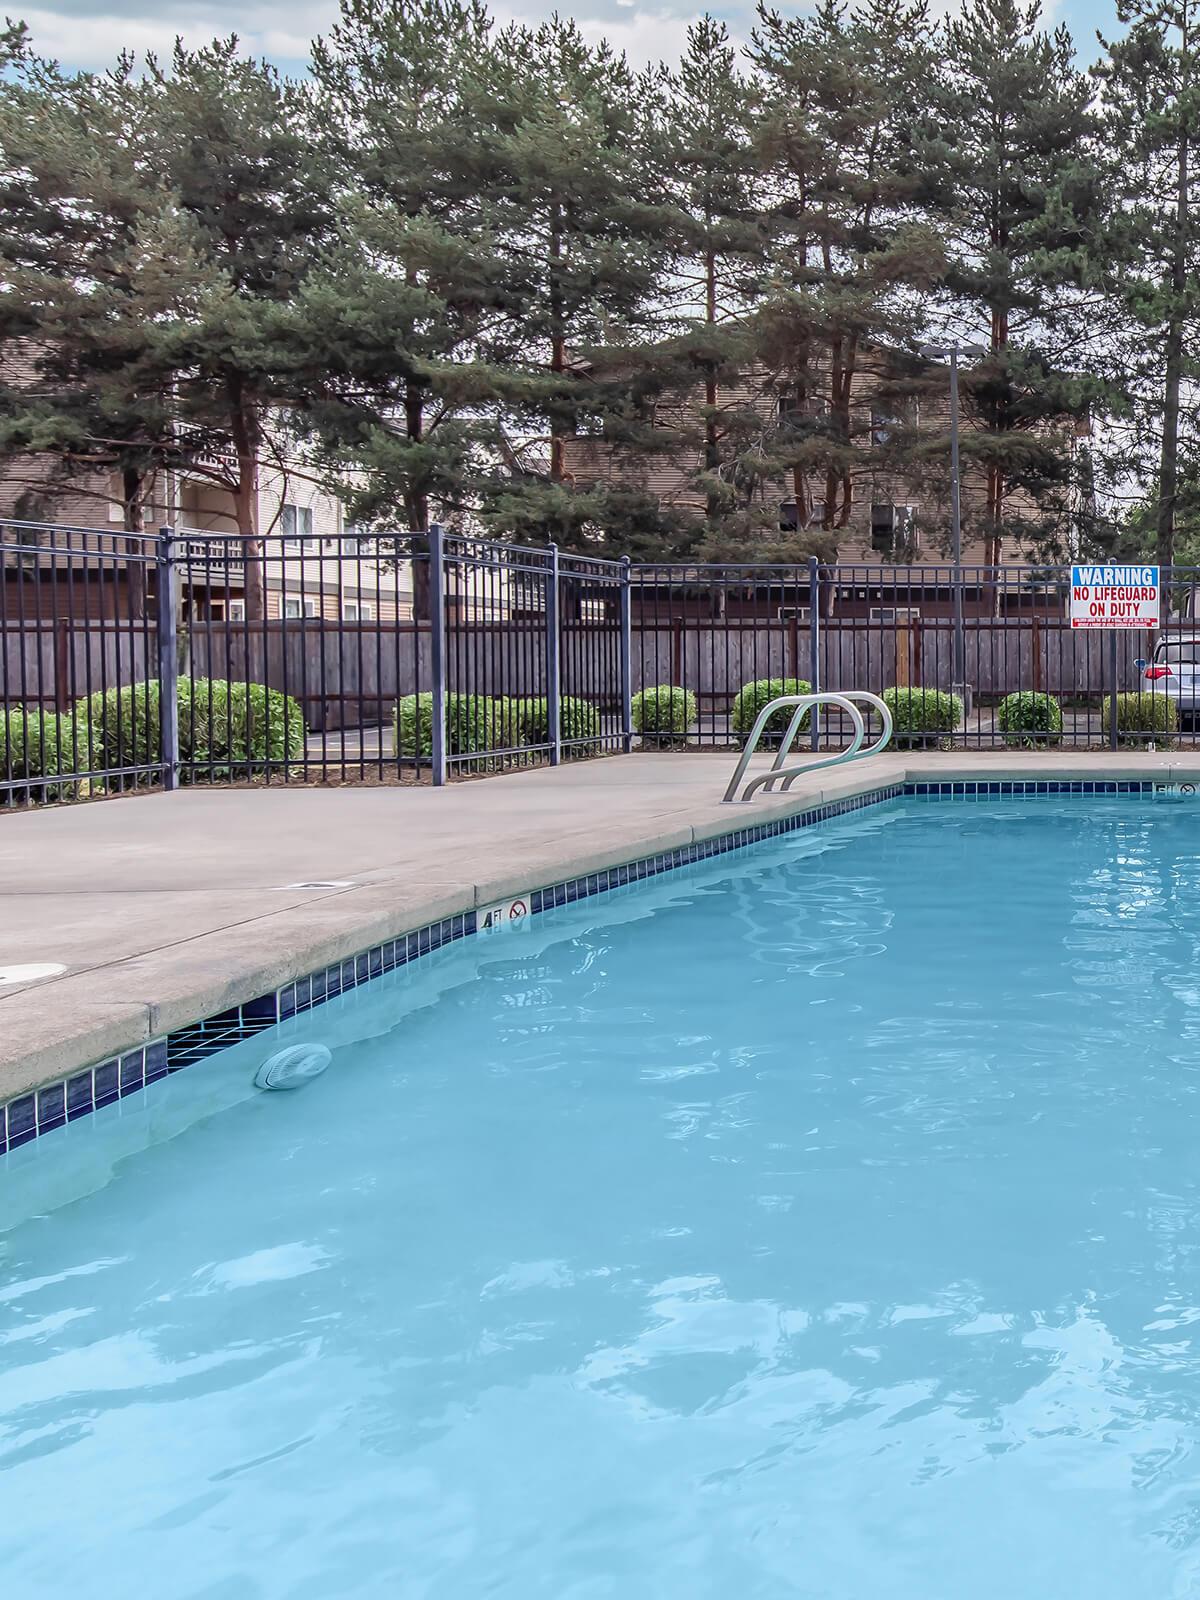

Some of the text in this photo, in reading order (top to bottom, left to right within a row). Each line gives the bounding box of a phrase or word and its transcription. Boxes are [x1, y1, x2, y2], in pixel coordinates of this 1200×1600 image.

[1078, 568, 1153, 585] WARNING
[1074, 587, 1157, 601] NO LIFEGUARD
[1089, 602, 1141, 617] ON DUTY
